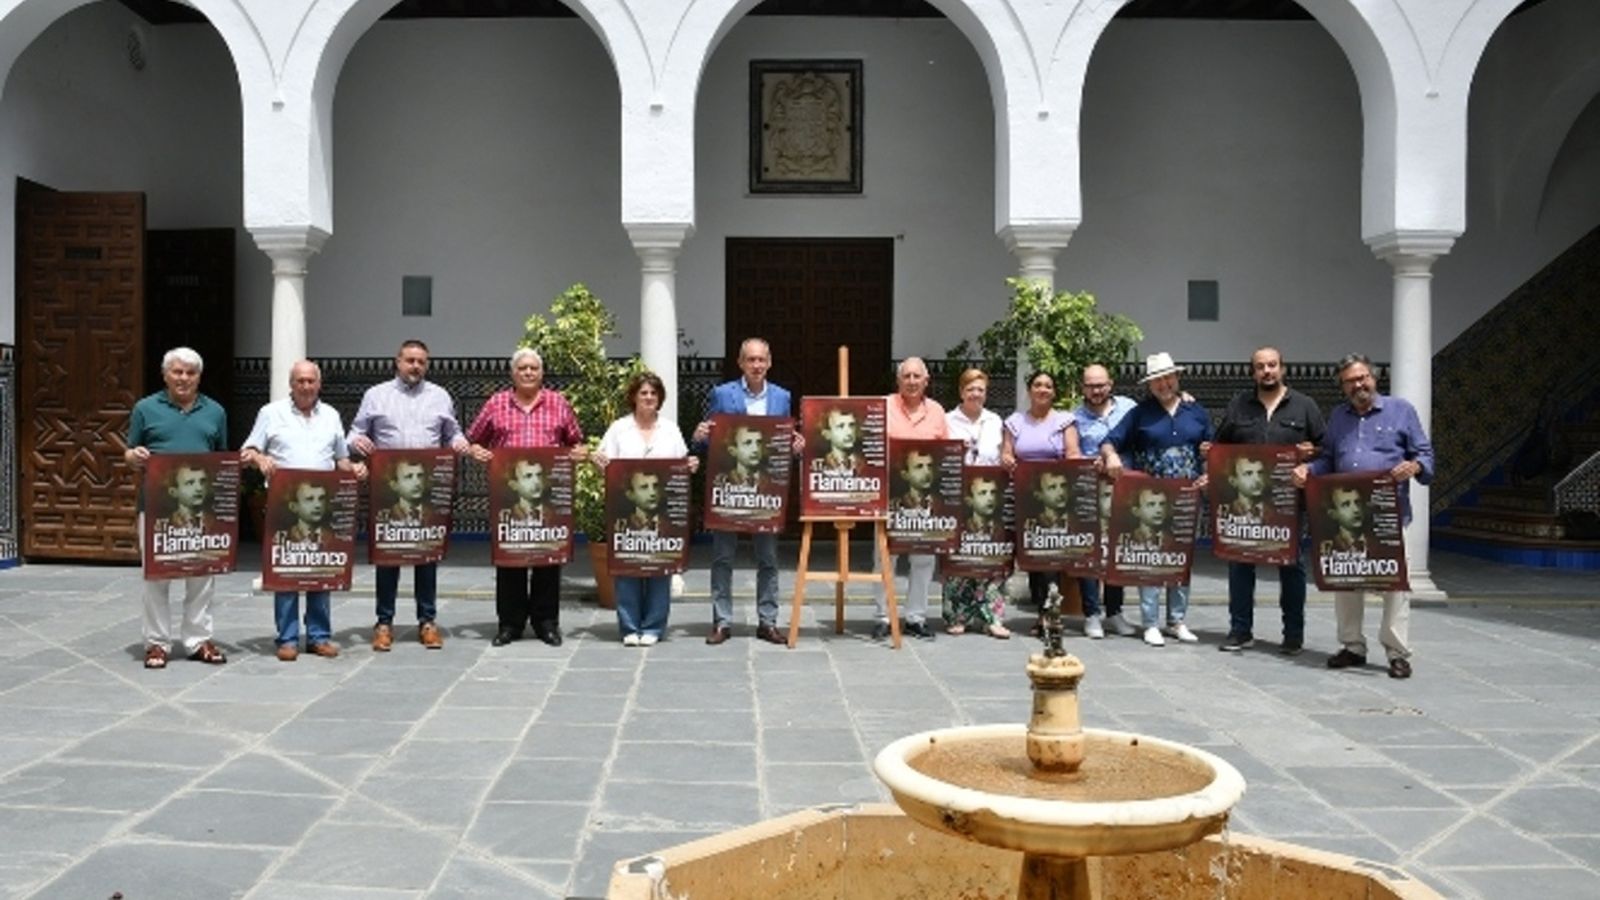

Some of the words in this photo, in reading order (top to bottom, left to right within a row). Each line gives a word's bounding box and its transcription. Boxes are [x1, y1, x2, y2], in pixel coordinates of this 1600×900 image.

[809, 472, 880, 491] Flamenco
[712, 487, 782, 509] Flamenco
[375, 523, 447, 541] Flamenco
[498, 523, 569, 541] Flamenco
[1216, 517, 1291, 541] Flamenco
[153, 532, 231, 553] Flamenco
[614, 532, 684, 551] Flamenco
[960, 541, 1015, 556] amenco
[1023, 531, 1095, 548] Flamenco
[272, 545, 348, 566] Flamenco
[1115, 544, 1187, 566] Flamenco
[1320, 555, 1398, 575] Flamenco
